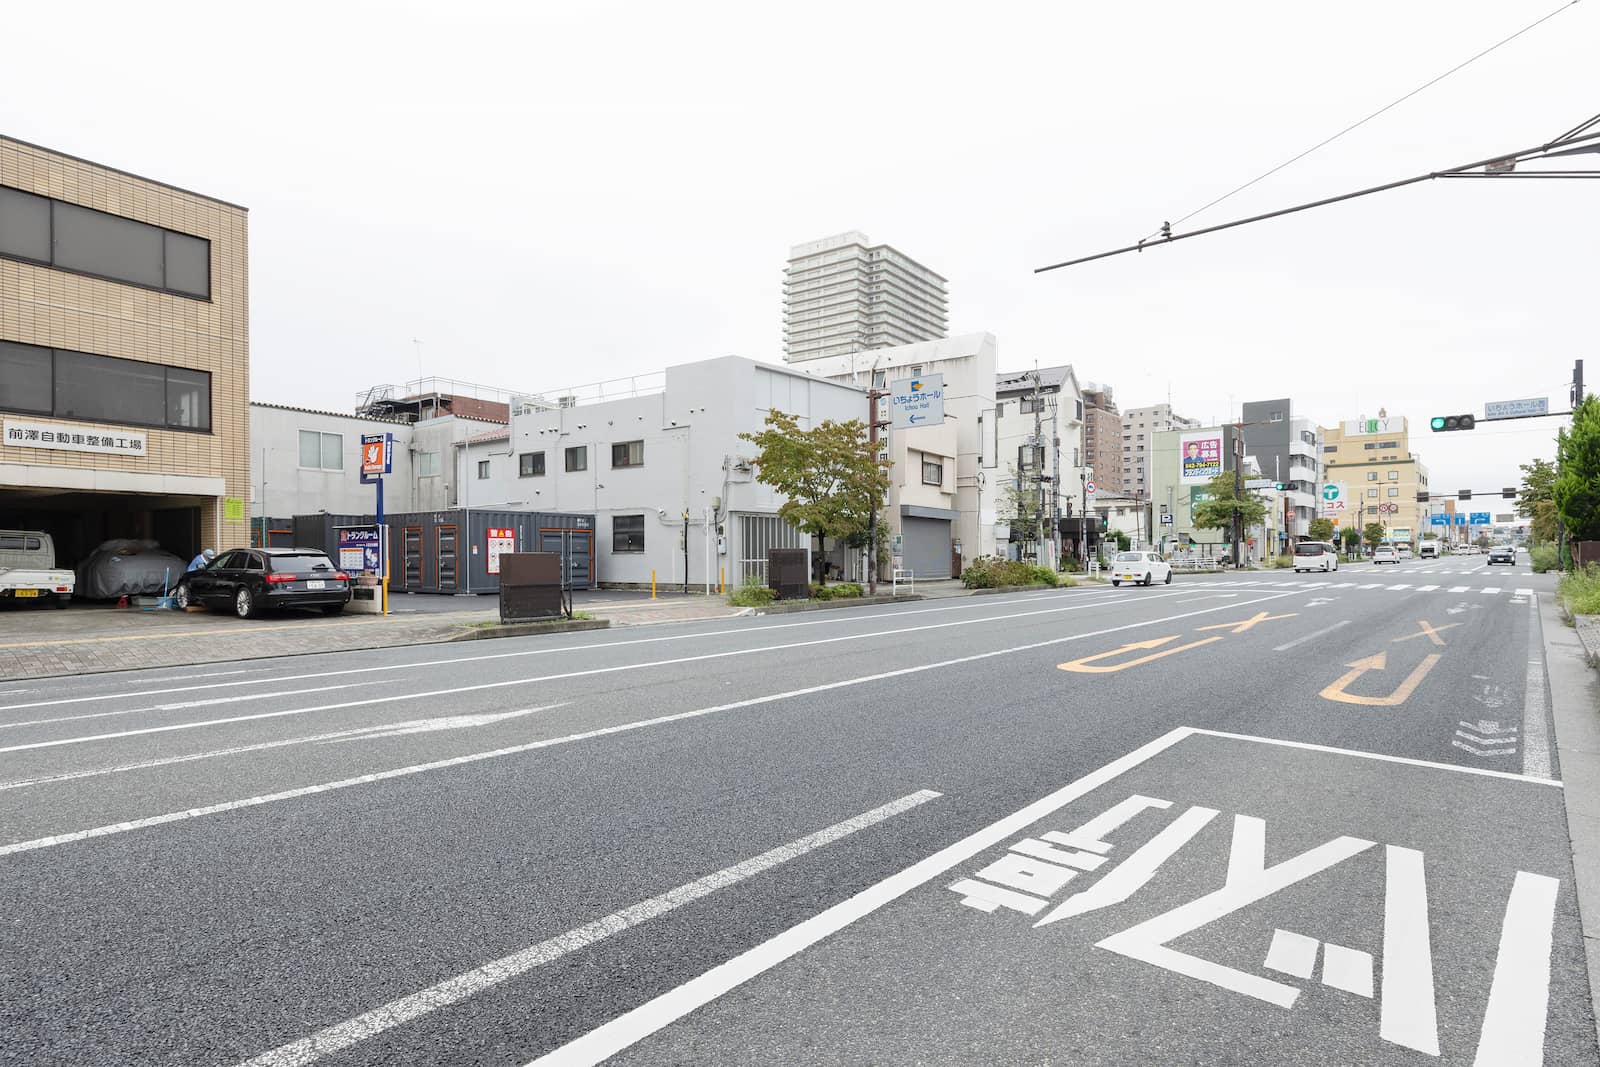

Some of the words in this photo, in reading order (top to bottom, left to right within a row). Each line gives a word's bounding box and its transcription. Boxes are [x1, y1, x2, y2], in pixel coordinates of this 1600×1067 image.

[893, 390, 941, 405] いちょうホール
[8, 427, 142, 450] 前澤自動車整備工場
[1201, 441, 1217, 449] 広告
[1323, 501, 1345, 509] コス
[347, 531, 378, 540] トランクルーム
